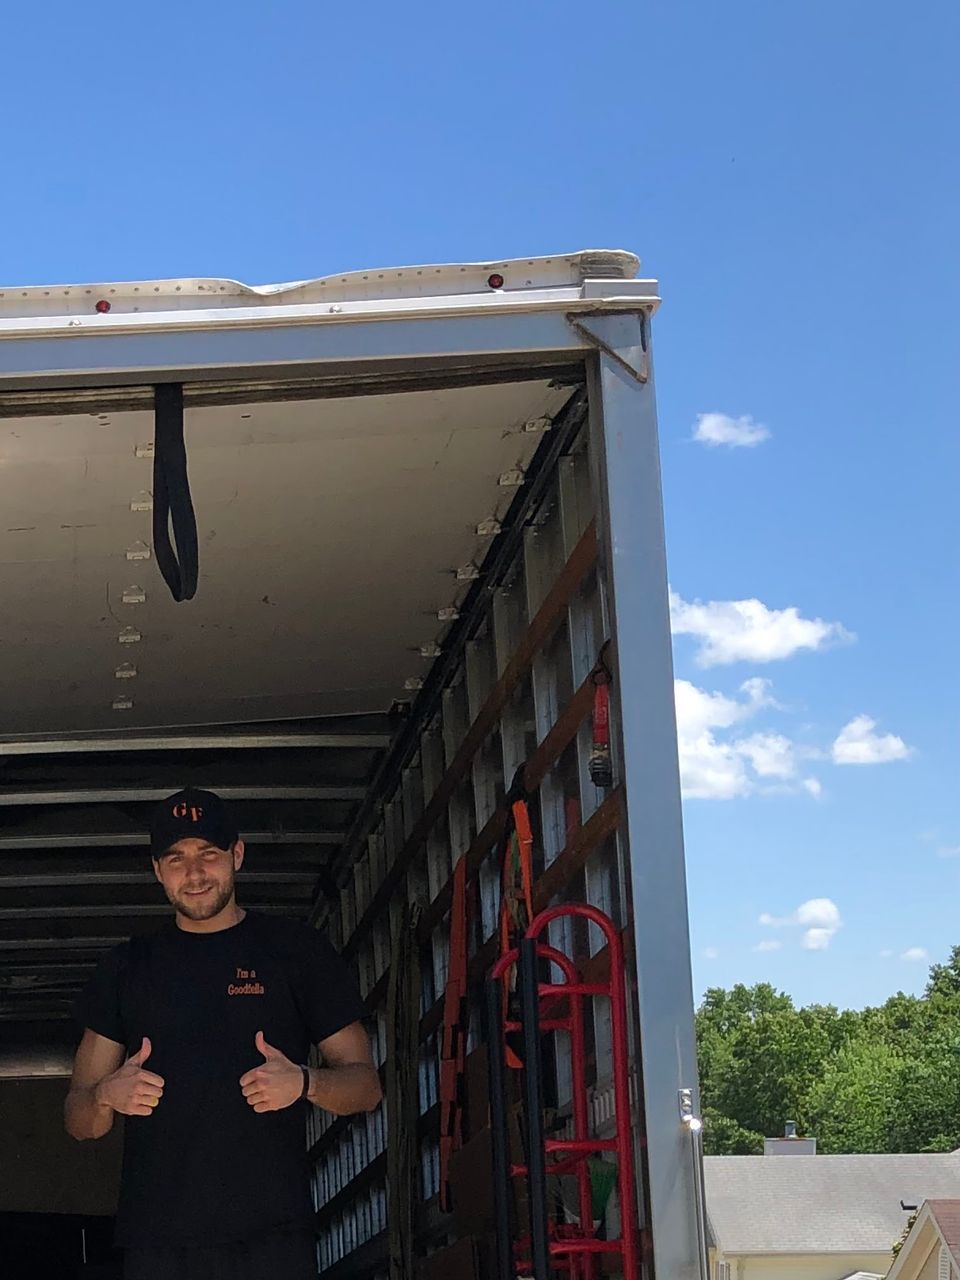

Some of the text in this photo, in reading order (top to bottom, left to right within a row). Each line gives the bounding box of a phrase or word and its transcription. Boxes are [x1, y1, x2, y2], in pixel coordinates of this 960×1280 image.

[236, 967, 257, 978] I'm a
[227, 982, 265, 996] Goodfella
